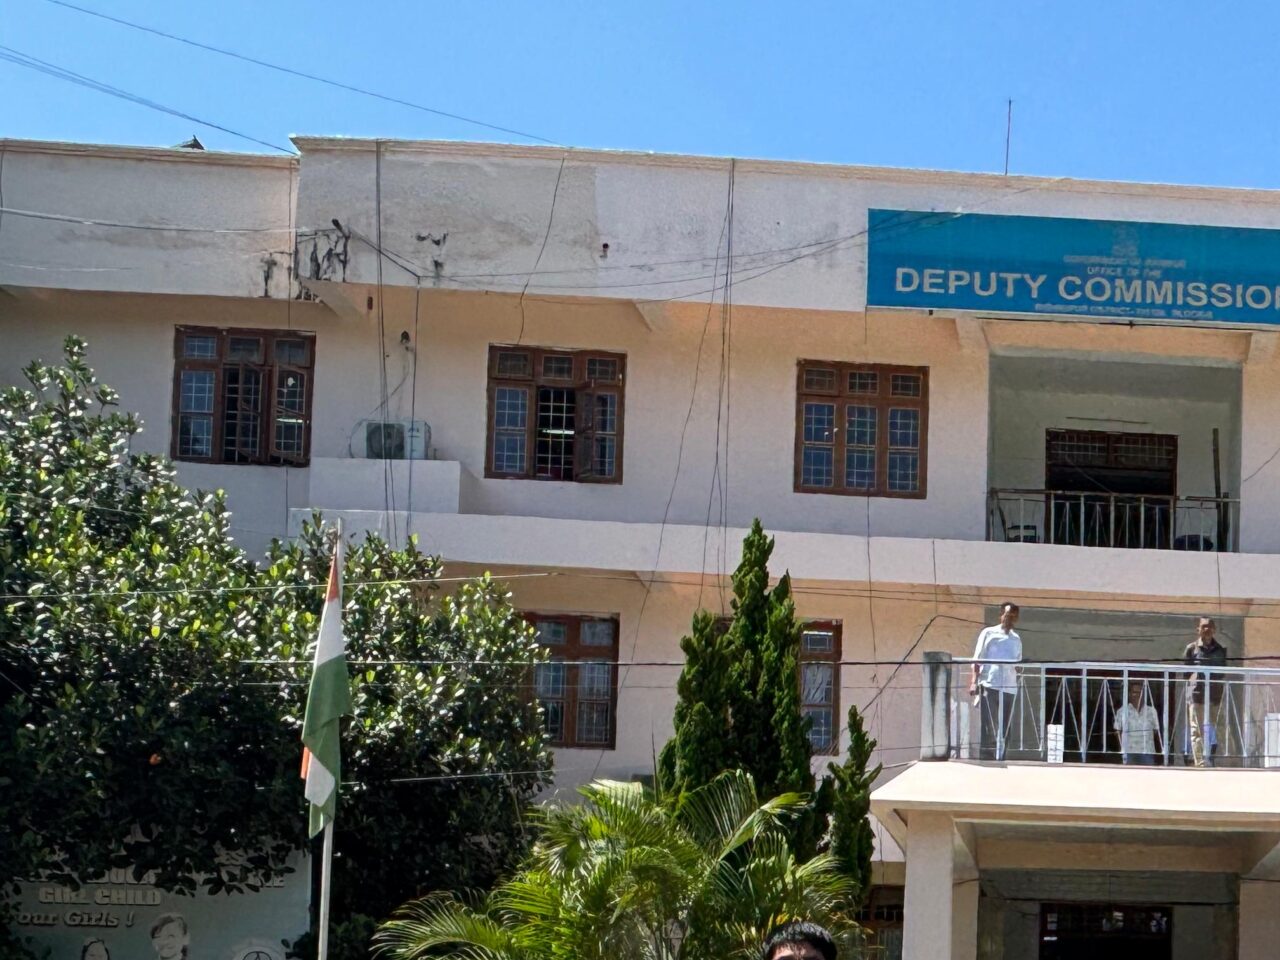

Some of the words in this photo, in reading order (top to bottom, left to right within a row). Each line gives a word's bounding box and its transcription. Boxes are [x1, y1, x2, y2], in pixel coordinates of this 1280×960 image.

[895, 267, 1047, 299] DEPUTY
[95, 887, 160, 906] CHILD
[64, 910, 120, 927] Girls
